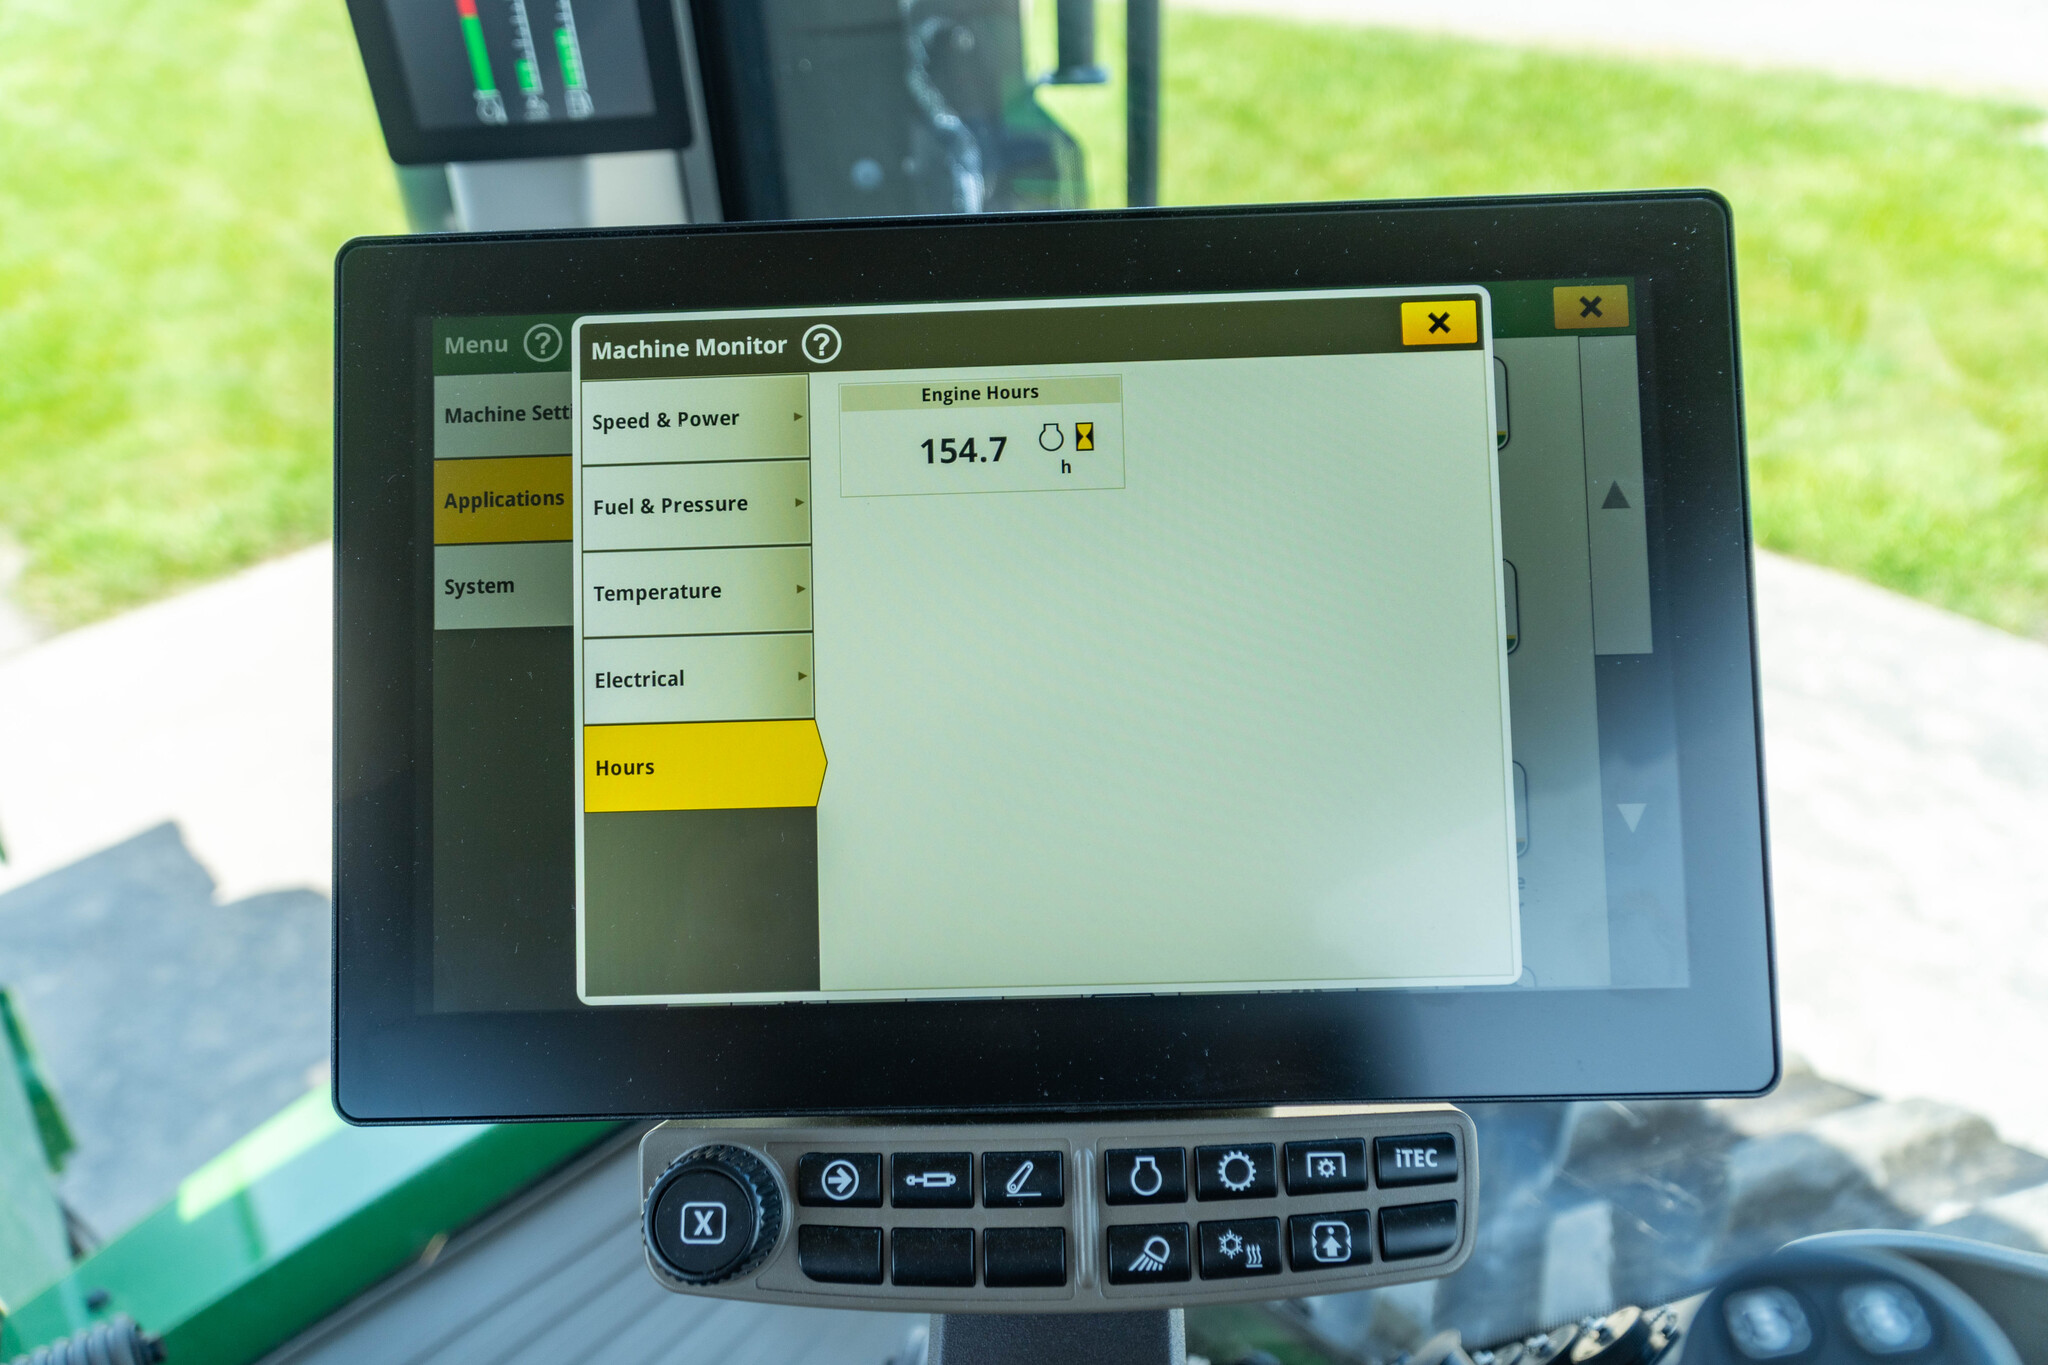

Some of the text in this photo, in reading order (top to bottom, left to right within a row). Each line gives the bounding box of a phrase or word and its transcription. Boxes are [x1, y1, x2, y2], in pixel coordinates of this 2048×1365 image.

[445, 335, 509, 356] Menu
[591, 334, 789, 361] Machine Monitor
[921, 385, 1040, 406] Engine Hours
[444, 404, 527, 425] Machine
[591, 410, 741, 435] Speed & Power
[920, 436, 1008, 464] 154.7
[1060, 459, 1072, 474] h
[443, 489, 566, 514] Applications
[593, 495, 750, 516] Fuel & Pressure
[444, 577, 516, 600] System
[593, 583, 723, 606] Temperature
[594, 669, 685, 689] Electrical
[595, 759, 656, 777] Hours
[1395, 1147, 1439, 1169] iTEC
